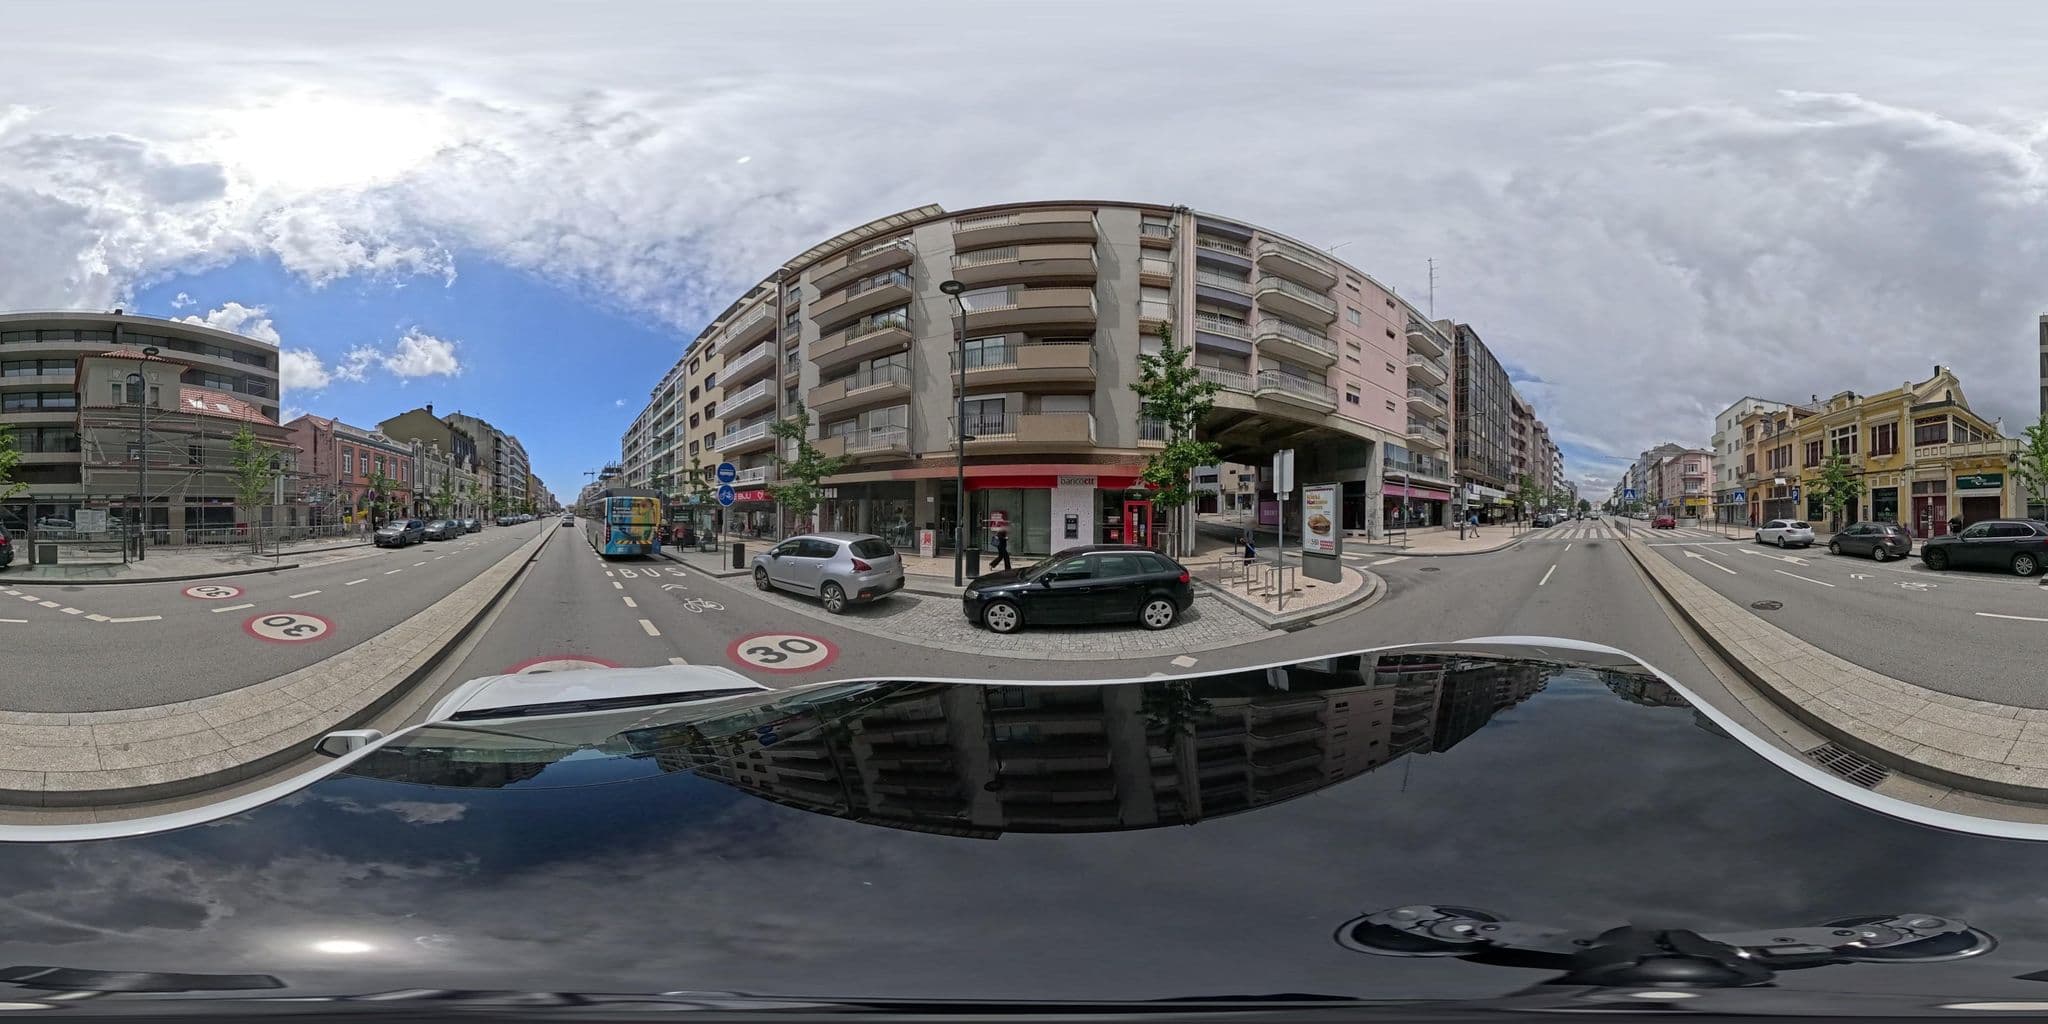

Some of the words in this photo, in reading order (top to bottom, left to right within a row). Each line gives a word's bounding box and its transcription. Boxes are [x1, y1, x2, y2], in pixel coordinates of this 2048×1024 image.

[618, 567, 687, 578] BUS
[196, 586, 231, 598] 30
[262, 615, 318, 637] 30
[746, 638, 818, 664] 30
